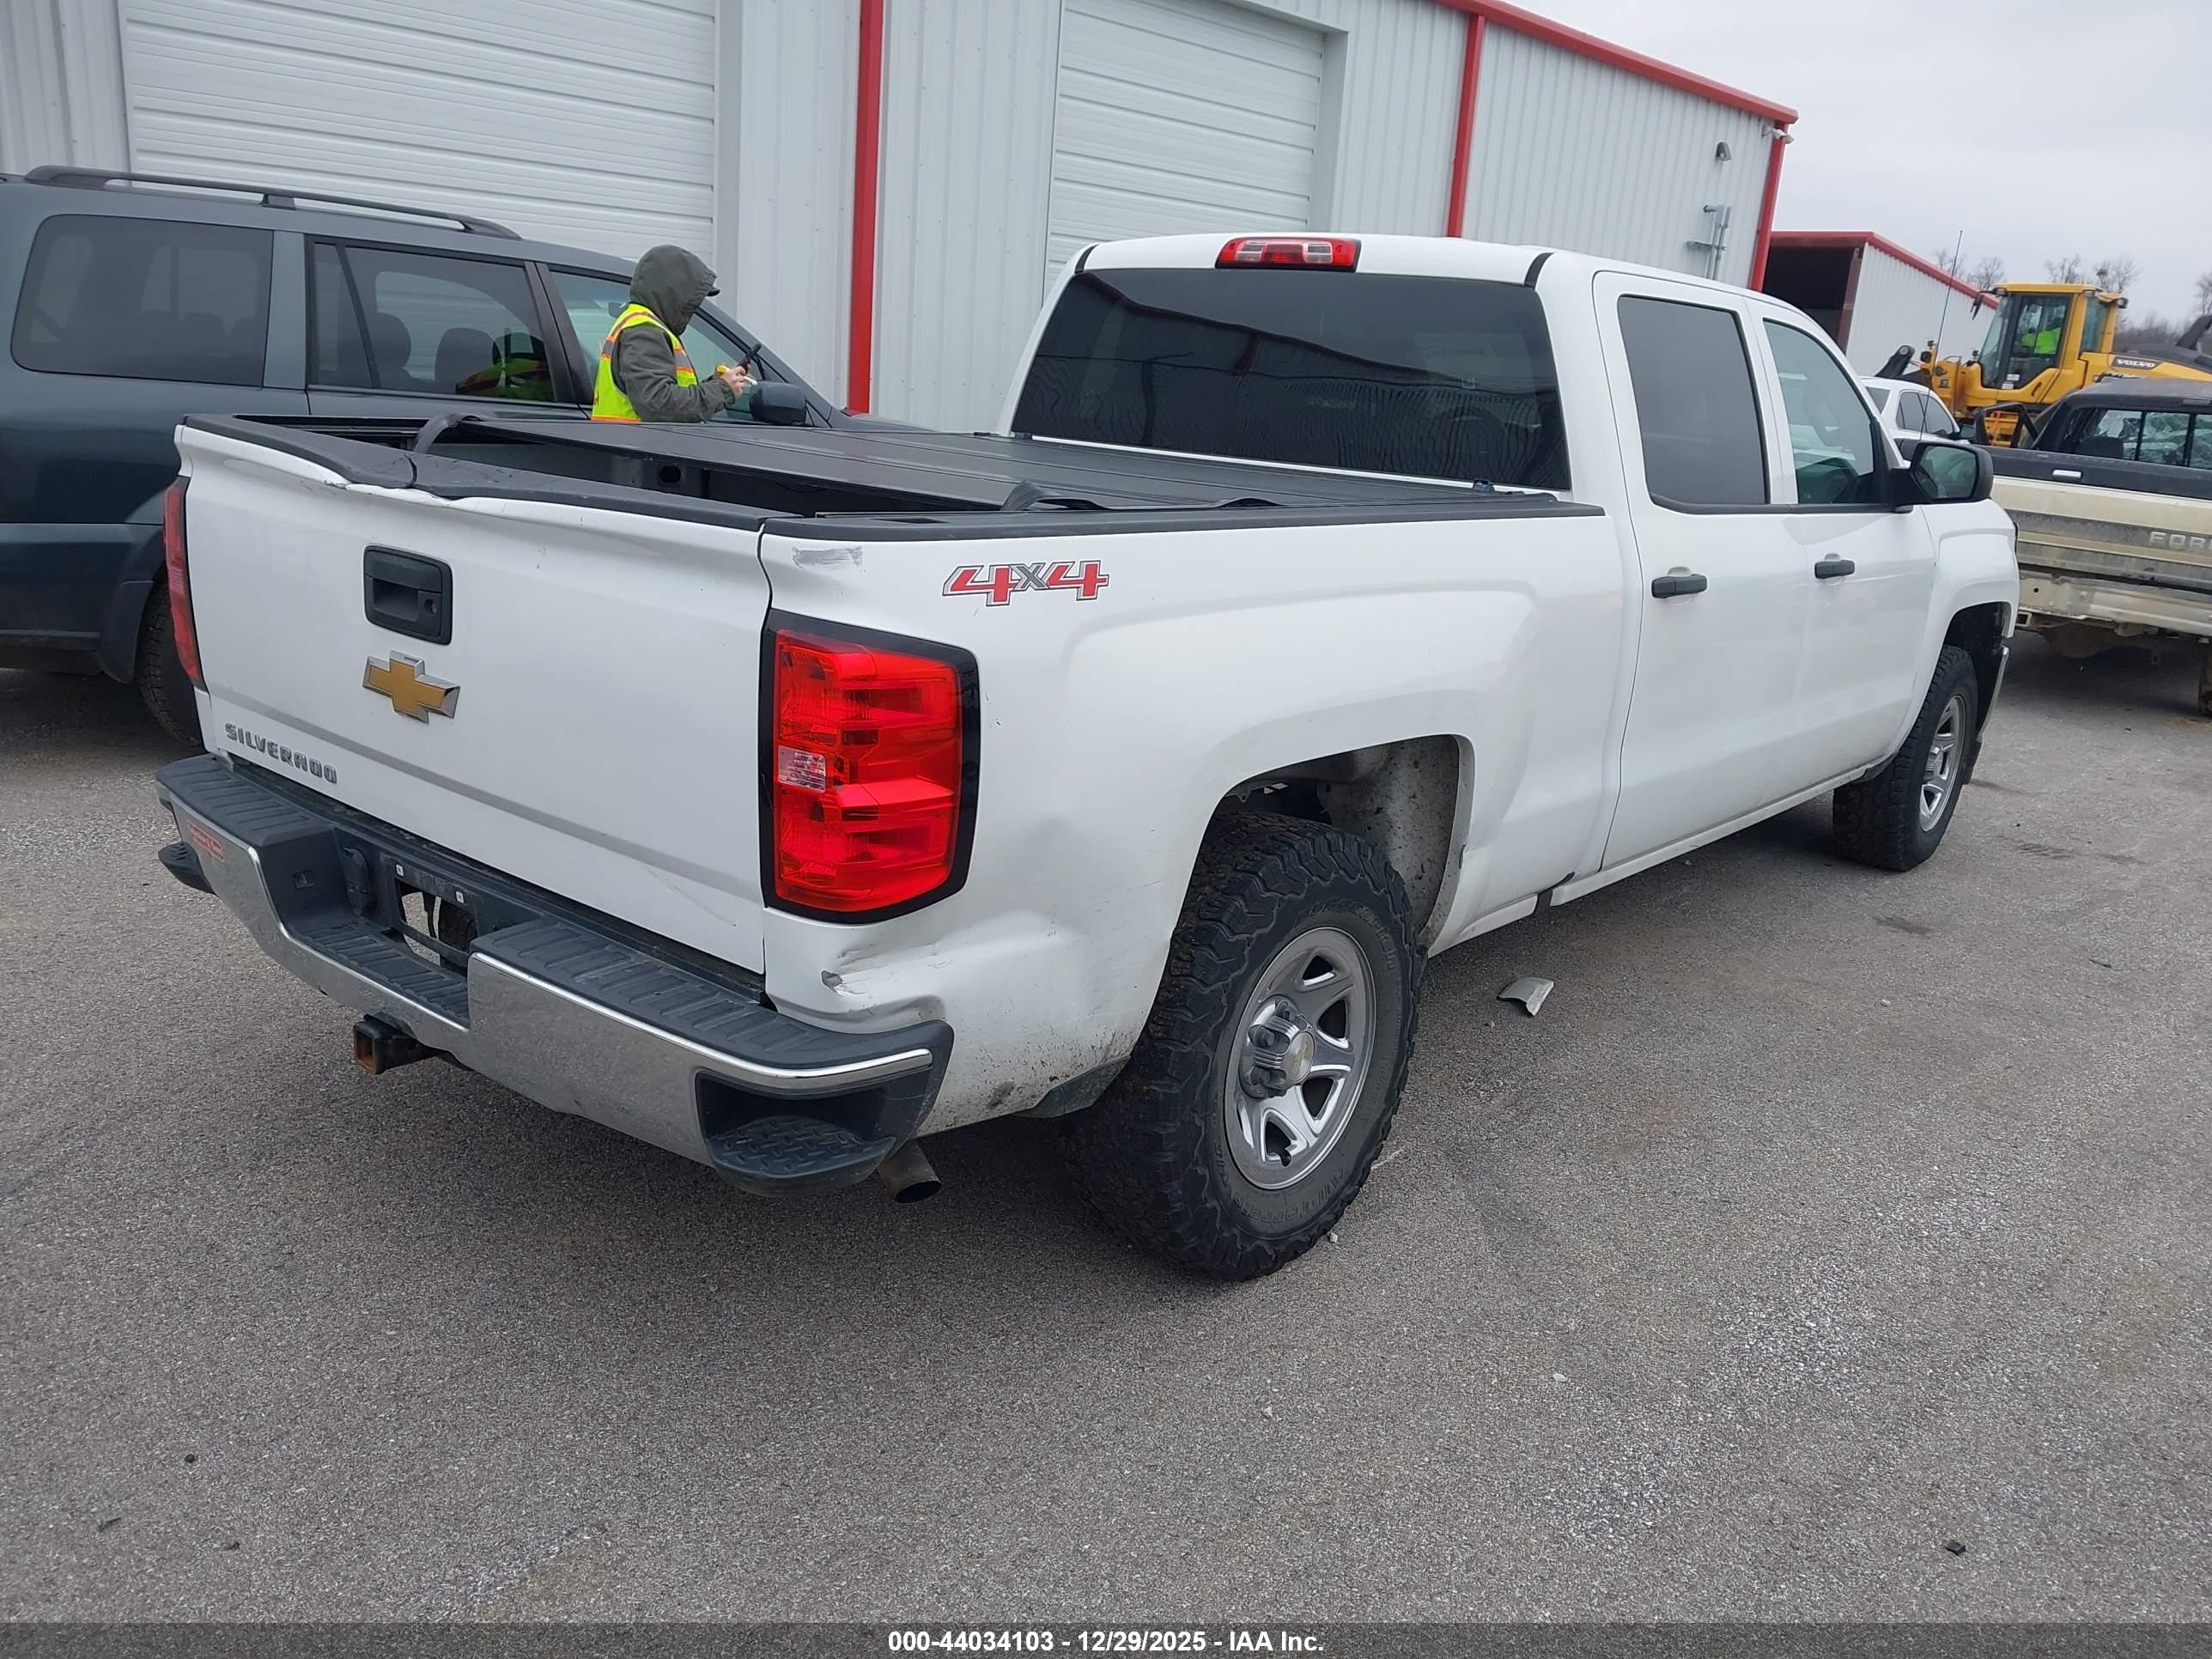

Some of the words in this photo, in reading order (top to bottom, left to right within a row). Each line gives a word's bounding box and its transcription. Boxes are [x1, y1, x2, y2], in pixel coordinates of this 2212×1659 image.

[2117, 358, 2156, 368] VOLVO
[2148, 531, 2212, 550] FOR
[224, 722, 337, 784] SILVERADO
